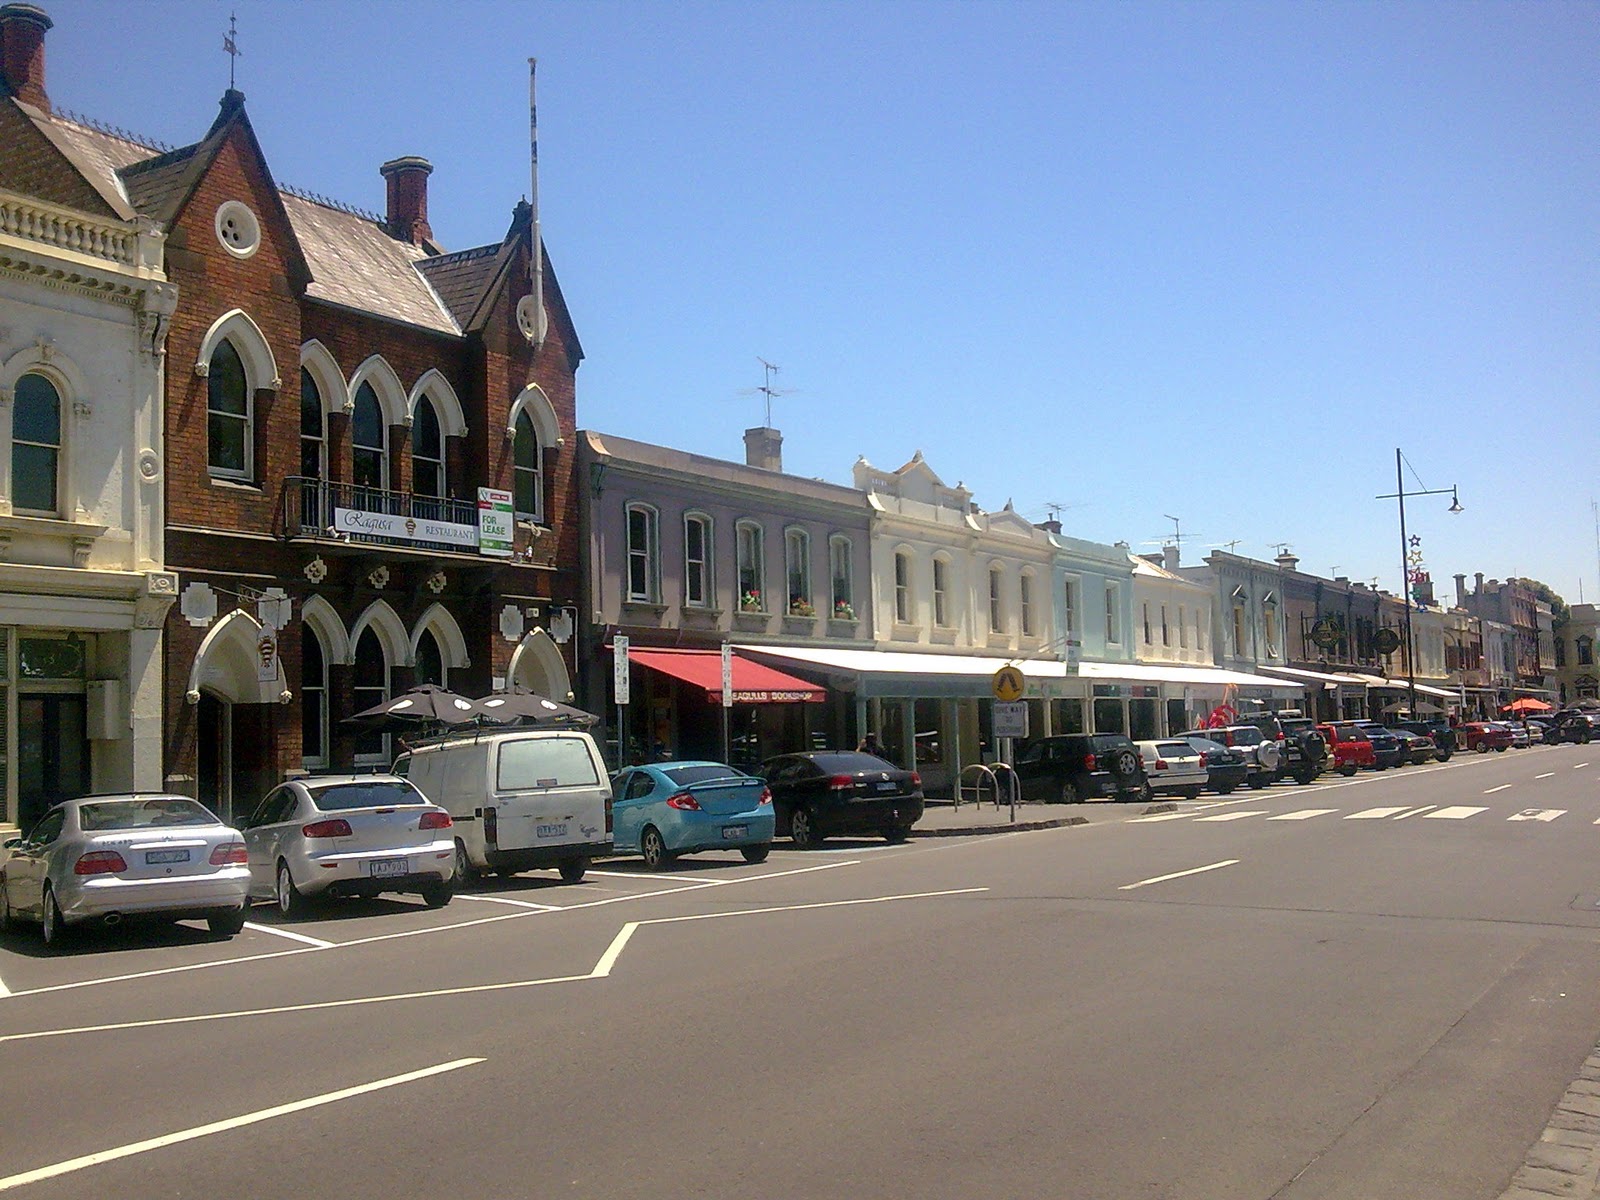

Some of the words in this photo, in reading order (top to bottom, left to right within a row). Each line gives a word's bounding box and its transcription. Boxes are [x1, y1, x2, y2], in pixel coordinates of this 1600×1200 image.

[482, 515, 497, 524] FOR
[344, 510, 393, 533] Ragusa
[425, 526, 474, 541] RESTAURANT
[482, 525, 506, 535] LEASE
[732, 692, 767, 700] EAGULLS
